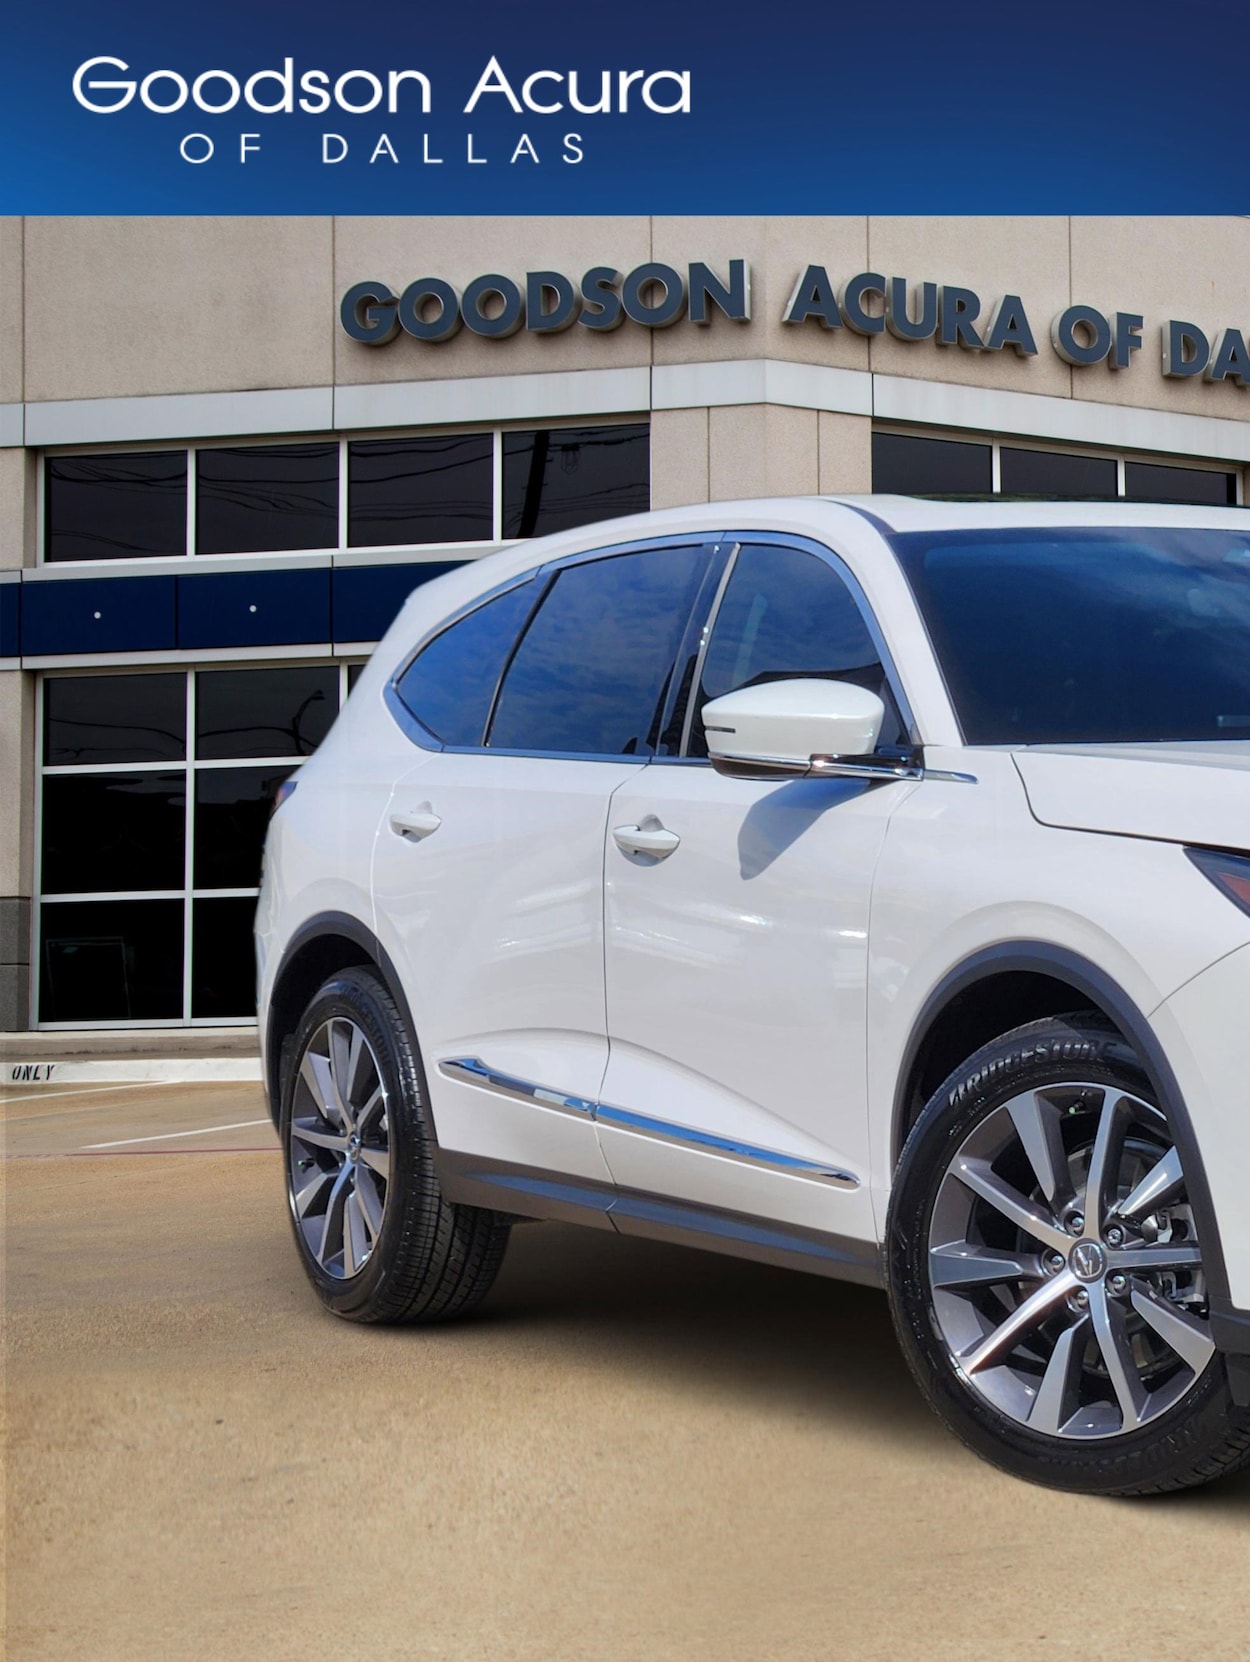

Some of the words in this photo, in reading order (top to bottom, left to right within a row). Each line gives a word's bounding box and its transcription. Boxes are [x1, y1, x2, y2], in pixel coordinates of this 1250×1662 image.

[340, 259, 750, 345] GOODSON
[782, 264, 1038, 357] ACURA
[1051, 304, 1143, 369] OF
[11, 1064, 55, 1081] ONLY
